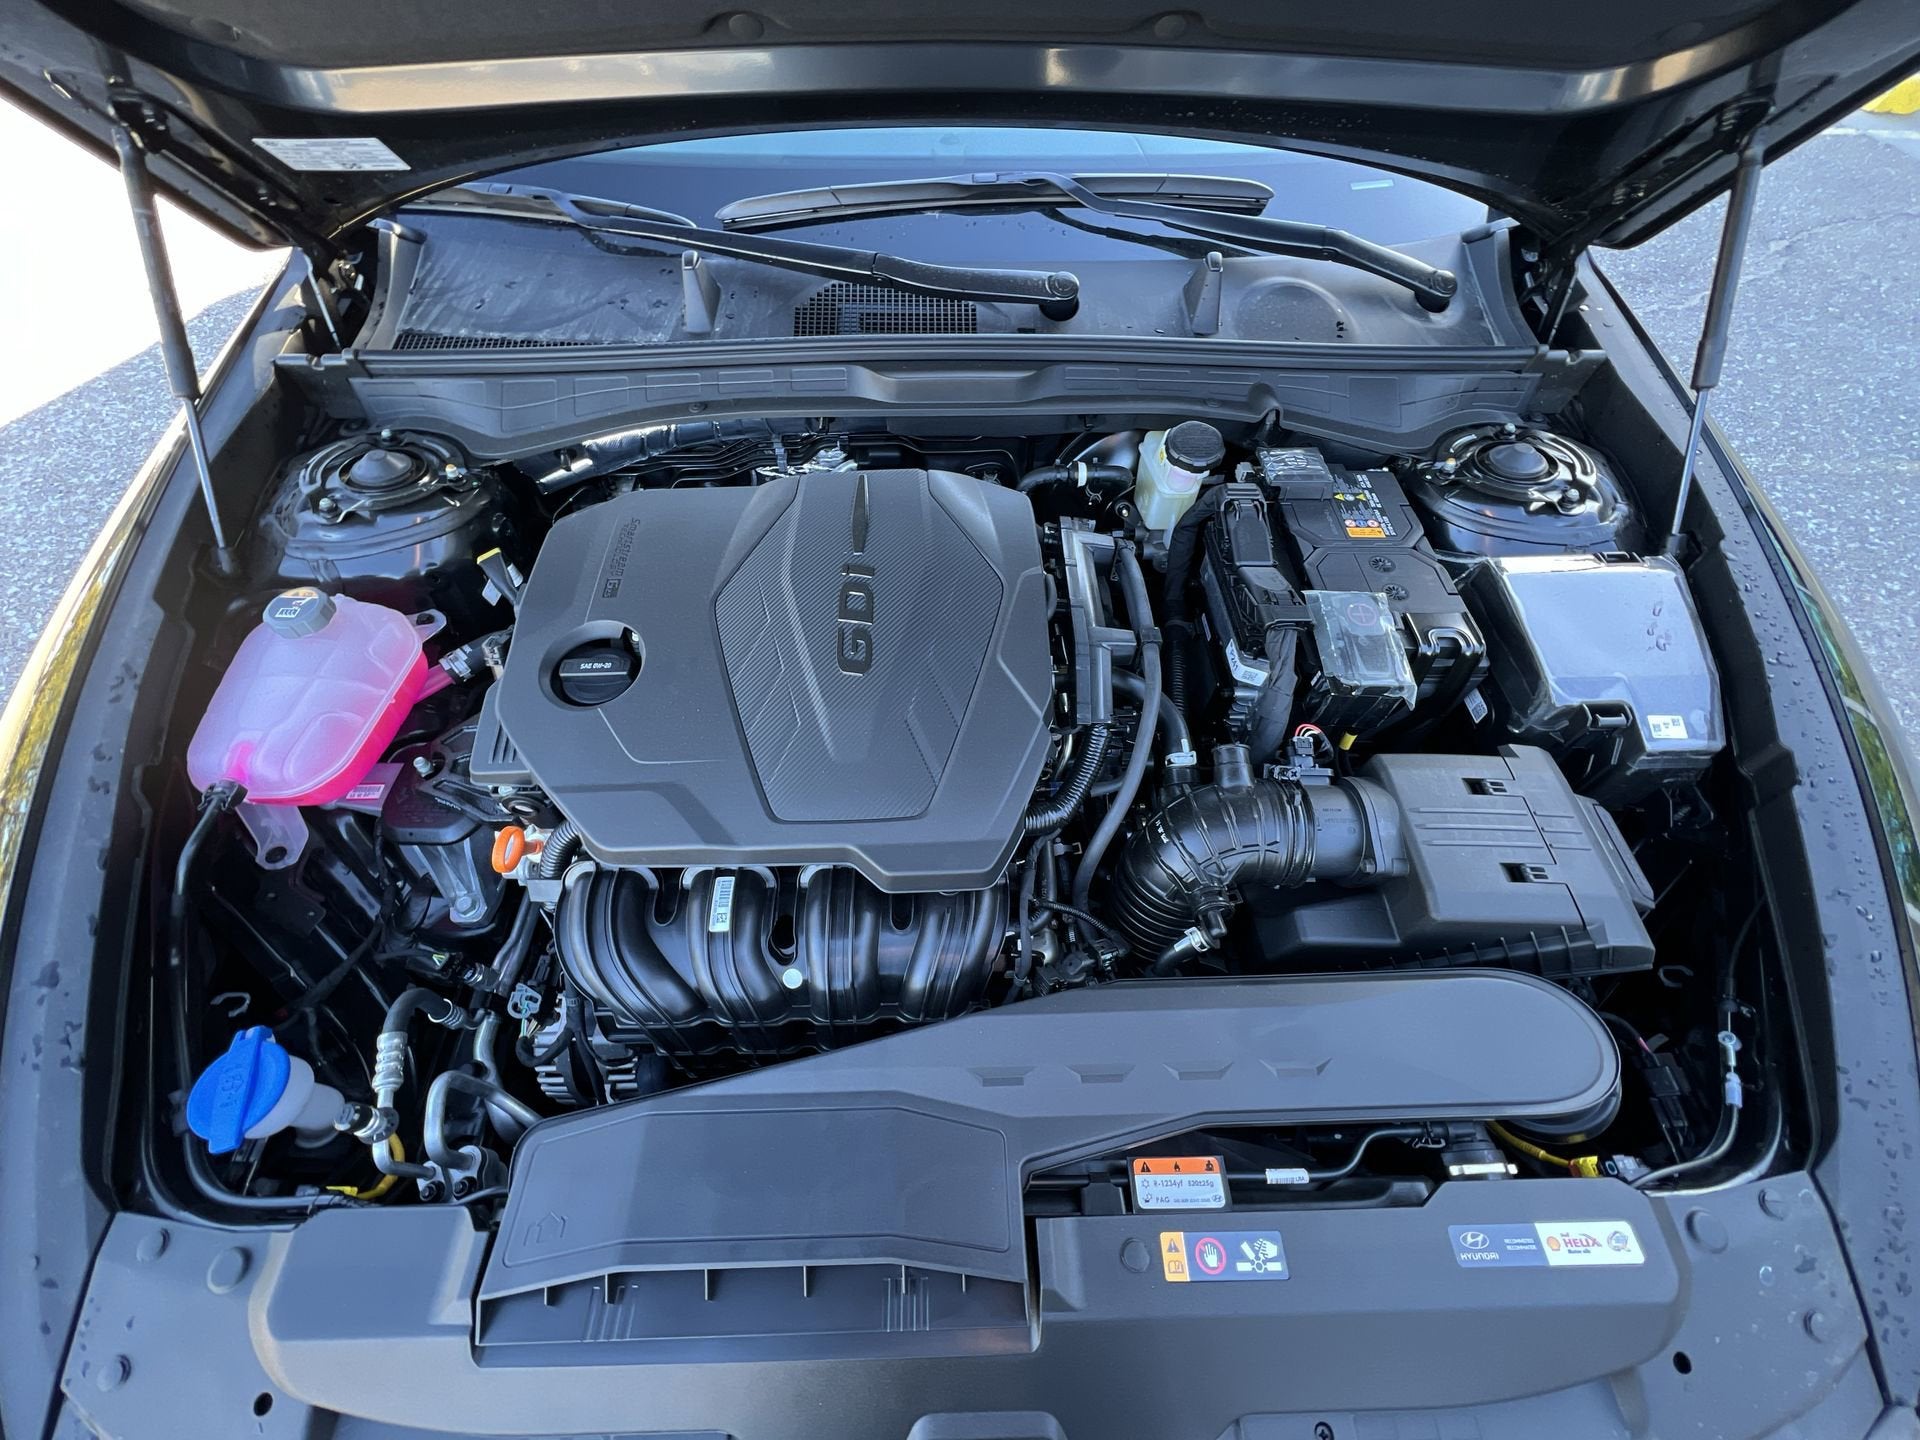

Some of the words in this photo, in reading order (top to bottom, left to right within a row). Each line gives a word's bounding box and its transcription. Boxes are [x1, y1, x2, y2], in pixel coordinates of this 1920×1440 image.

[614, 516, 641, 577] Smartstream
[836, 563, 875, 677] GDi
[580, 662, 592, 670] SAE
[1153, 1180, 1183, 1188] R-1234yf
[1562, 1237, 1600, 1248] HELIX
[1461, 1252, 1500, 1260] HYUNDAI
